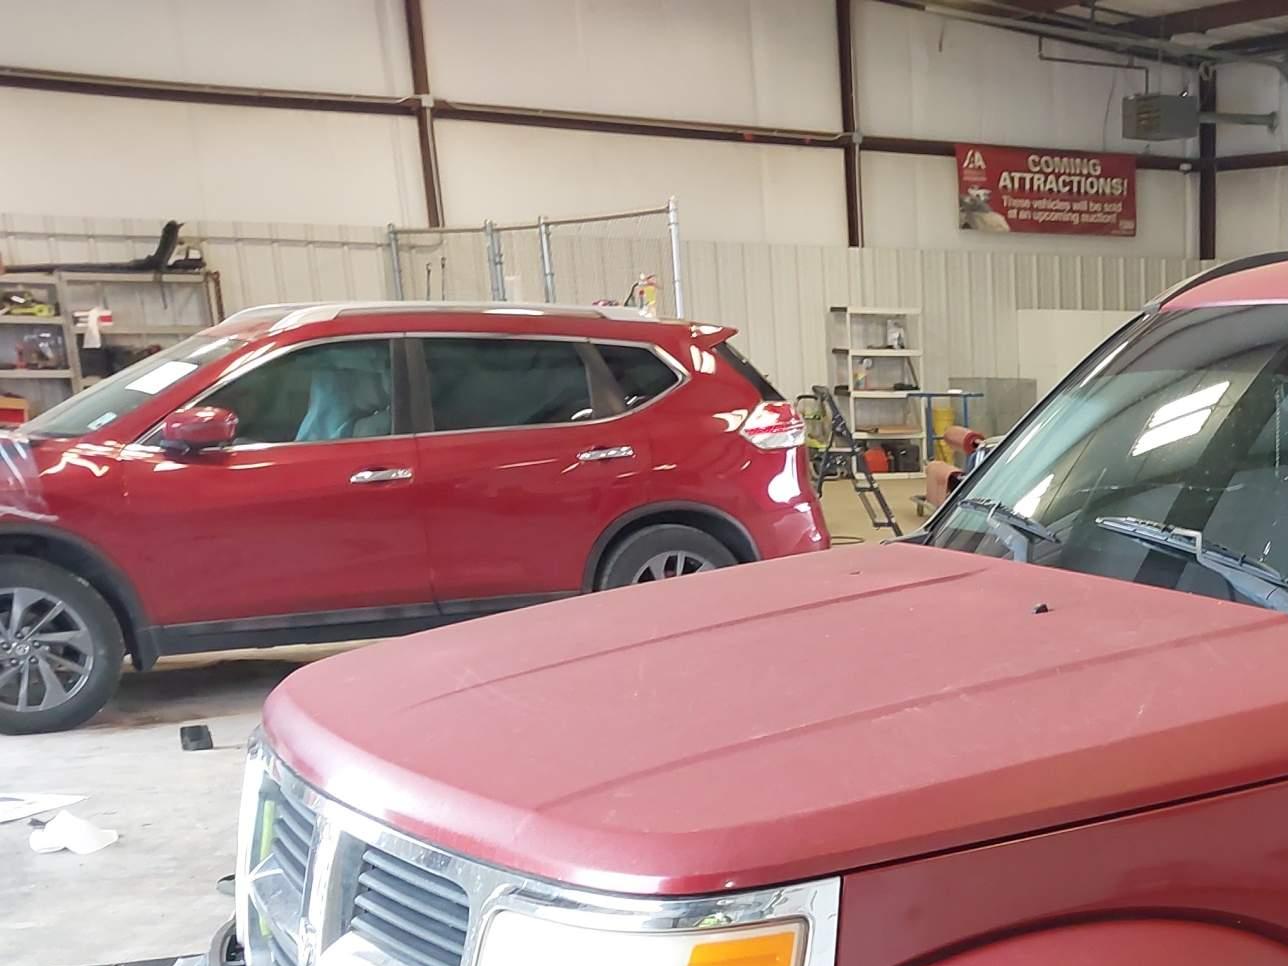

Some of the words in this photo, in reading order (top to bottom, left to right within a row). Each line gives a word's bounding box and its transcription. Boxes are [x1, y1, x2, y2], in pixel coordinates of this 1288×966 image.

[1027, 154, 1101, 175] COMING
[998, 171, 1128, 196] ATTRACTIONS!
[1002, 195, 1030, 208] These
[1089, 201, 1102, 212] be
